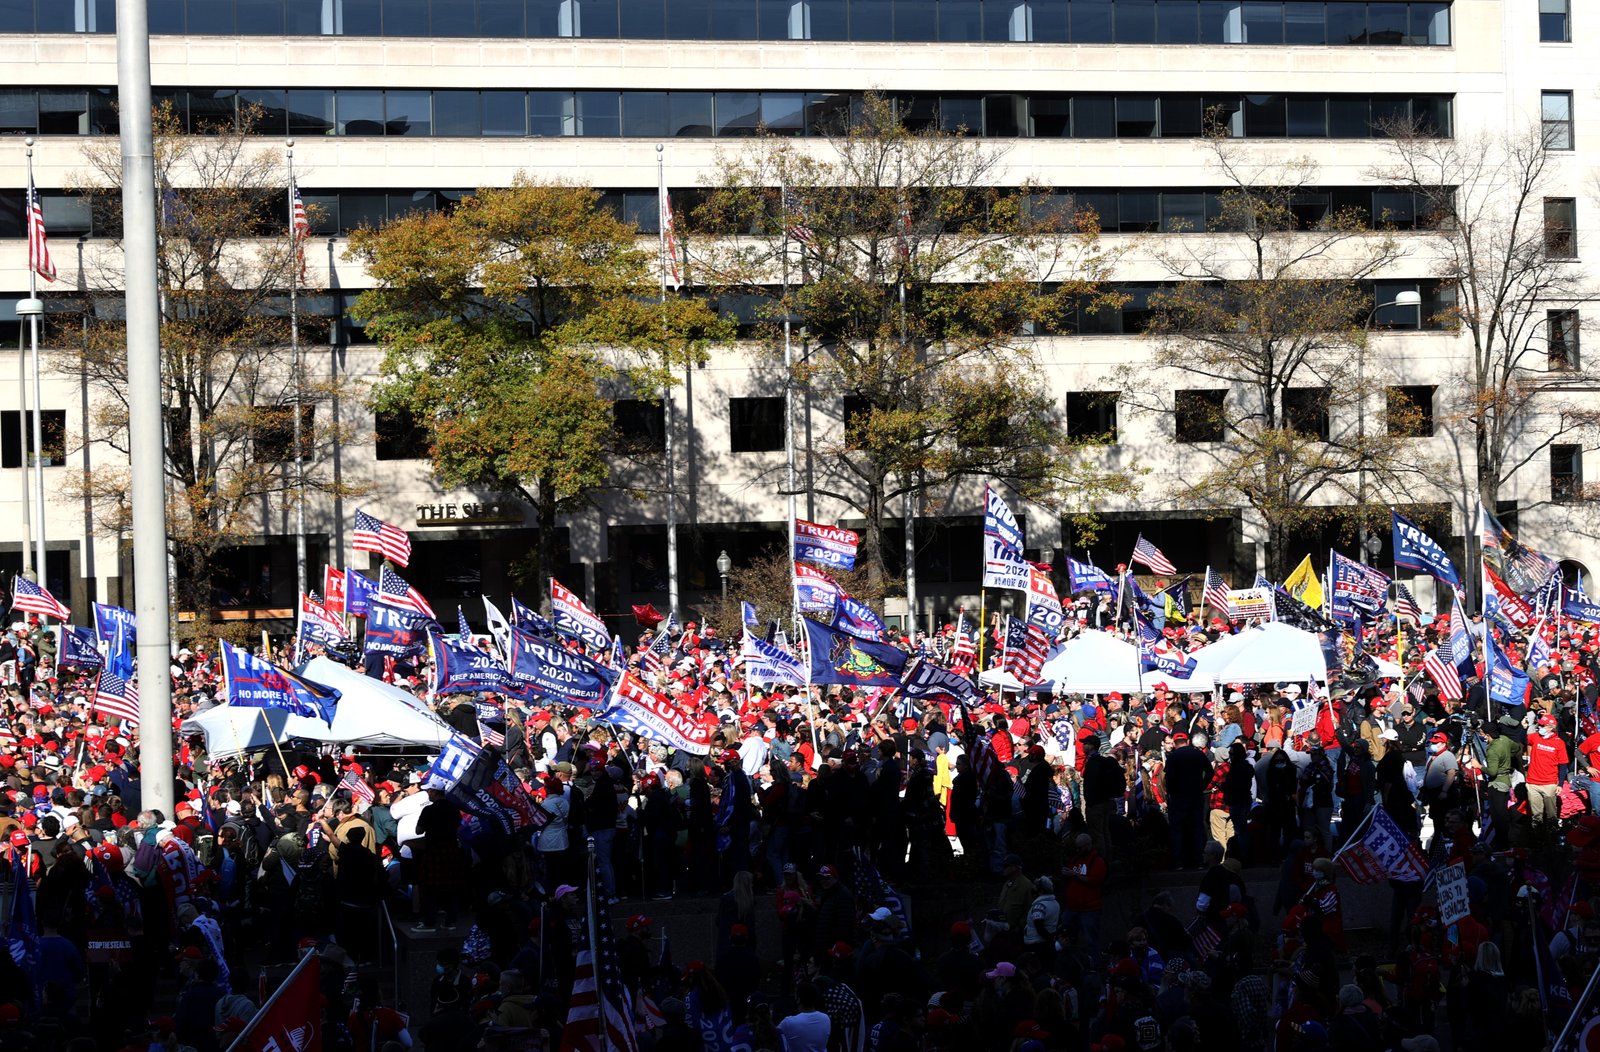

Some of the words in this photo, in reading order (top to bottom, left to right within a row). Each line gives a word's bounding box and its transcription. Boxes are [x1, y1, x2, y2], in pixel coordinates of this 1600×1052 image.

[416, 503, 457, 519] THE
[462, 502, 503, 519] SHO
[798, 523, 856, 543] TRUMP
[804, 546, 841, 563] 2020
[1033, 605, 1062, 626] 20
[557, 612, 606, 648] 2020
[366, 641, 381, 651] NO
[381, 643, 405, 654] MORE
[449, 673, 468, 682] KEEP
[538, 664, 578, 684] -2020-
[514, 671, 536, 681] KEEP
[535, 677, 569, 694] AMERICA
[570, 686, 598, 698] GREAT!
[239, 690, 252, 699] NO
[253, 690, 281, 700] MORE
[626, 681, 707, 740] TRUMP
[639, 709, 674, 737] AMERICA
[673, 733, 705, 755] GREAT!
